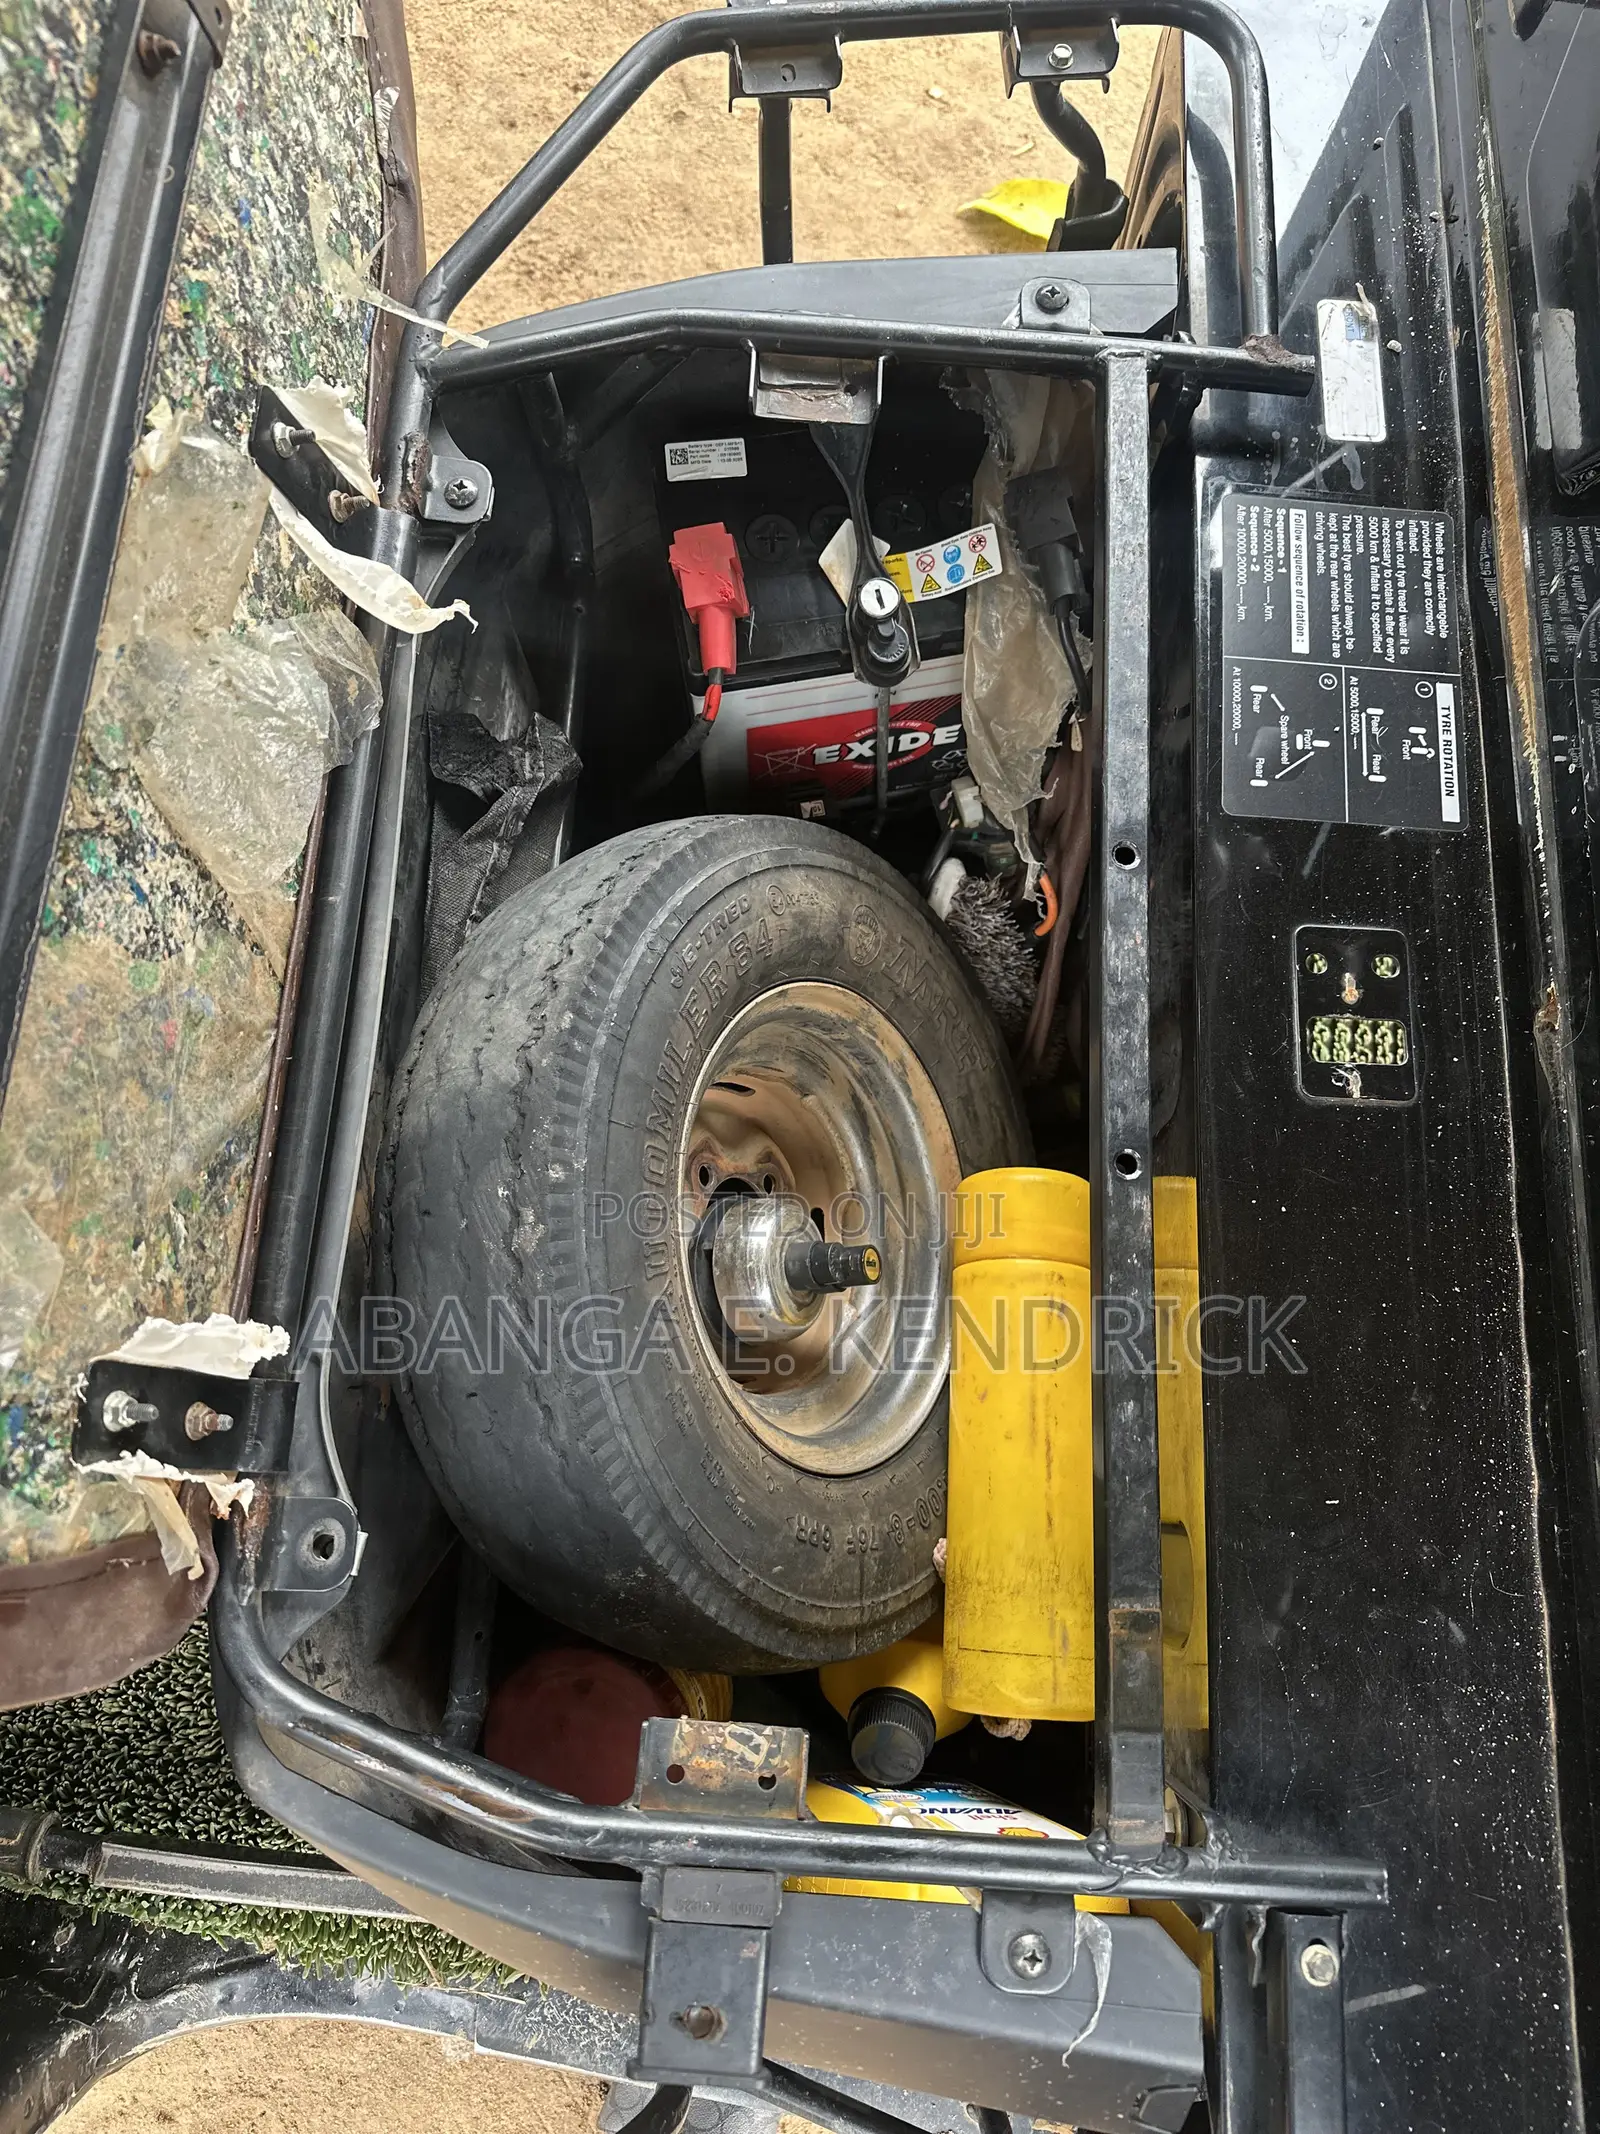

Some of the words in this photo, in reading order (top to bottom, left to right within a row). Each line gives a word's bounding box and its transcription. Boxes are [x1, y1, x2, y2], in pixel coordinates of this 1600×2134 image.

[1236, 504, 1246, 526] After
[1263, 506, 1272, 528] After
[1314, 512, 1325, 540] driving
[1328, 512, 1338, 531] kept
[1342, 514, 1352, 531] The
[1395, 519, 1405, 529] To
[1248, 506, 1260, 556] Sequence
[1275, 508, 1286, 558] Sequence
[1294, 512, 1304, 542] Follow
[1330, 533, 1338, 542] at
[1354, 515, 1364, 555] pressure.
[1368, 516, 1378, 538] 5000
[1409, 520, 1419, 554] inflated.
[1435, 522, 1445, 554] Wheels
[1342, 532, 1352, 552] best
[1370, 540, 1379, 554] km
[1382, 518, 1392, 567] neccessary
[1396, 531, 1404, 552] even
[1420, 520, 1432, 558] provided
[1262, 529, 1274, 584] 5000,15000,
[1316, 542, 1326, 576] wheels.
[1330, 544, 1340, 559] the
[1341, 554, 1352, 571] tyre
[1396, 554, 1406, 568] out
[1250, 564, 1260, 572] 2
[1293, 544, 1304, 586] sequence
[1330, 560, 1339, 579] rear
[1384, 569, 1393, 578] to
[1422, 560, 1432, 580] they
[1436, 556, 1444, 571] are
[1344, 572, 1354, 604] should
[1370, 565, 1380, 592] inflate
[1395, 570, 1406, 588] tyre
[1424, 581, 1432, 596] are
[1296, 589, 1305, 598] of
[1330, 580, 1340, 612] wheels
[1384, 580, 1394, 606] rotate
[1398, 590, 1408, 612] tread
[1372, 602, 1380, 610] to
[1424, 598, 1435, 636] correctly
[1436, 574, 1448, 638] interchangeble
[1296, 600, 1306, 636] rotation
[1331, 614, 1342, 640] which
[1343, 604, 1354, 636] always
[1385, 614, 1395, 636] after
[1400, 614, 1408, 637] wear
[1370, 612, 1382, 653] specified
[1332, 642, 1340, 658] are
[1346, 638, 1355, 650] be
[1384, 637, 1395, 663] every
[1400, 646, 1410, 654] is
[1232, 666, 1241, 676] At
[1350, 676, 1358, 685] At
[1232, 678, 1242, 730] 10000,20000,
[1252, 693, 1262, 714] Rear
[1350, 686, 1360, 736] 5000,15000,
[1278, 714, 1289, 739] Spare
[1371, 716, 1380, 735] Rear
[1440, 706, 1452, 736] TYRE
[812, 723, 962, 765] EXIDE
[1304, 728, 1313, 750] Front
[1402, 740, 1411, 760] Front
[1280, 740, 1290, 765] wheel
[1256, 758, 1264, 778] Rear
[1372, 754, 1381, 774] Rear
[1442, 740, 1454, 797] ROTATION
[727, 917, 774, 977] 84
[889, 1478, 947, 1548] .00-8
[908, 1807, 1023, 1816] ADVANC
